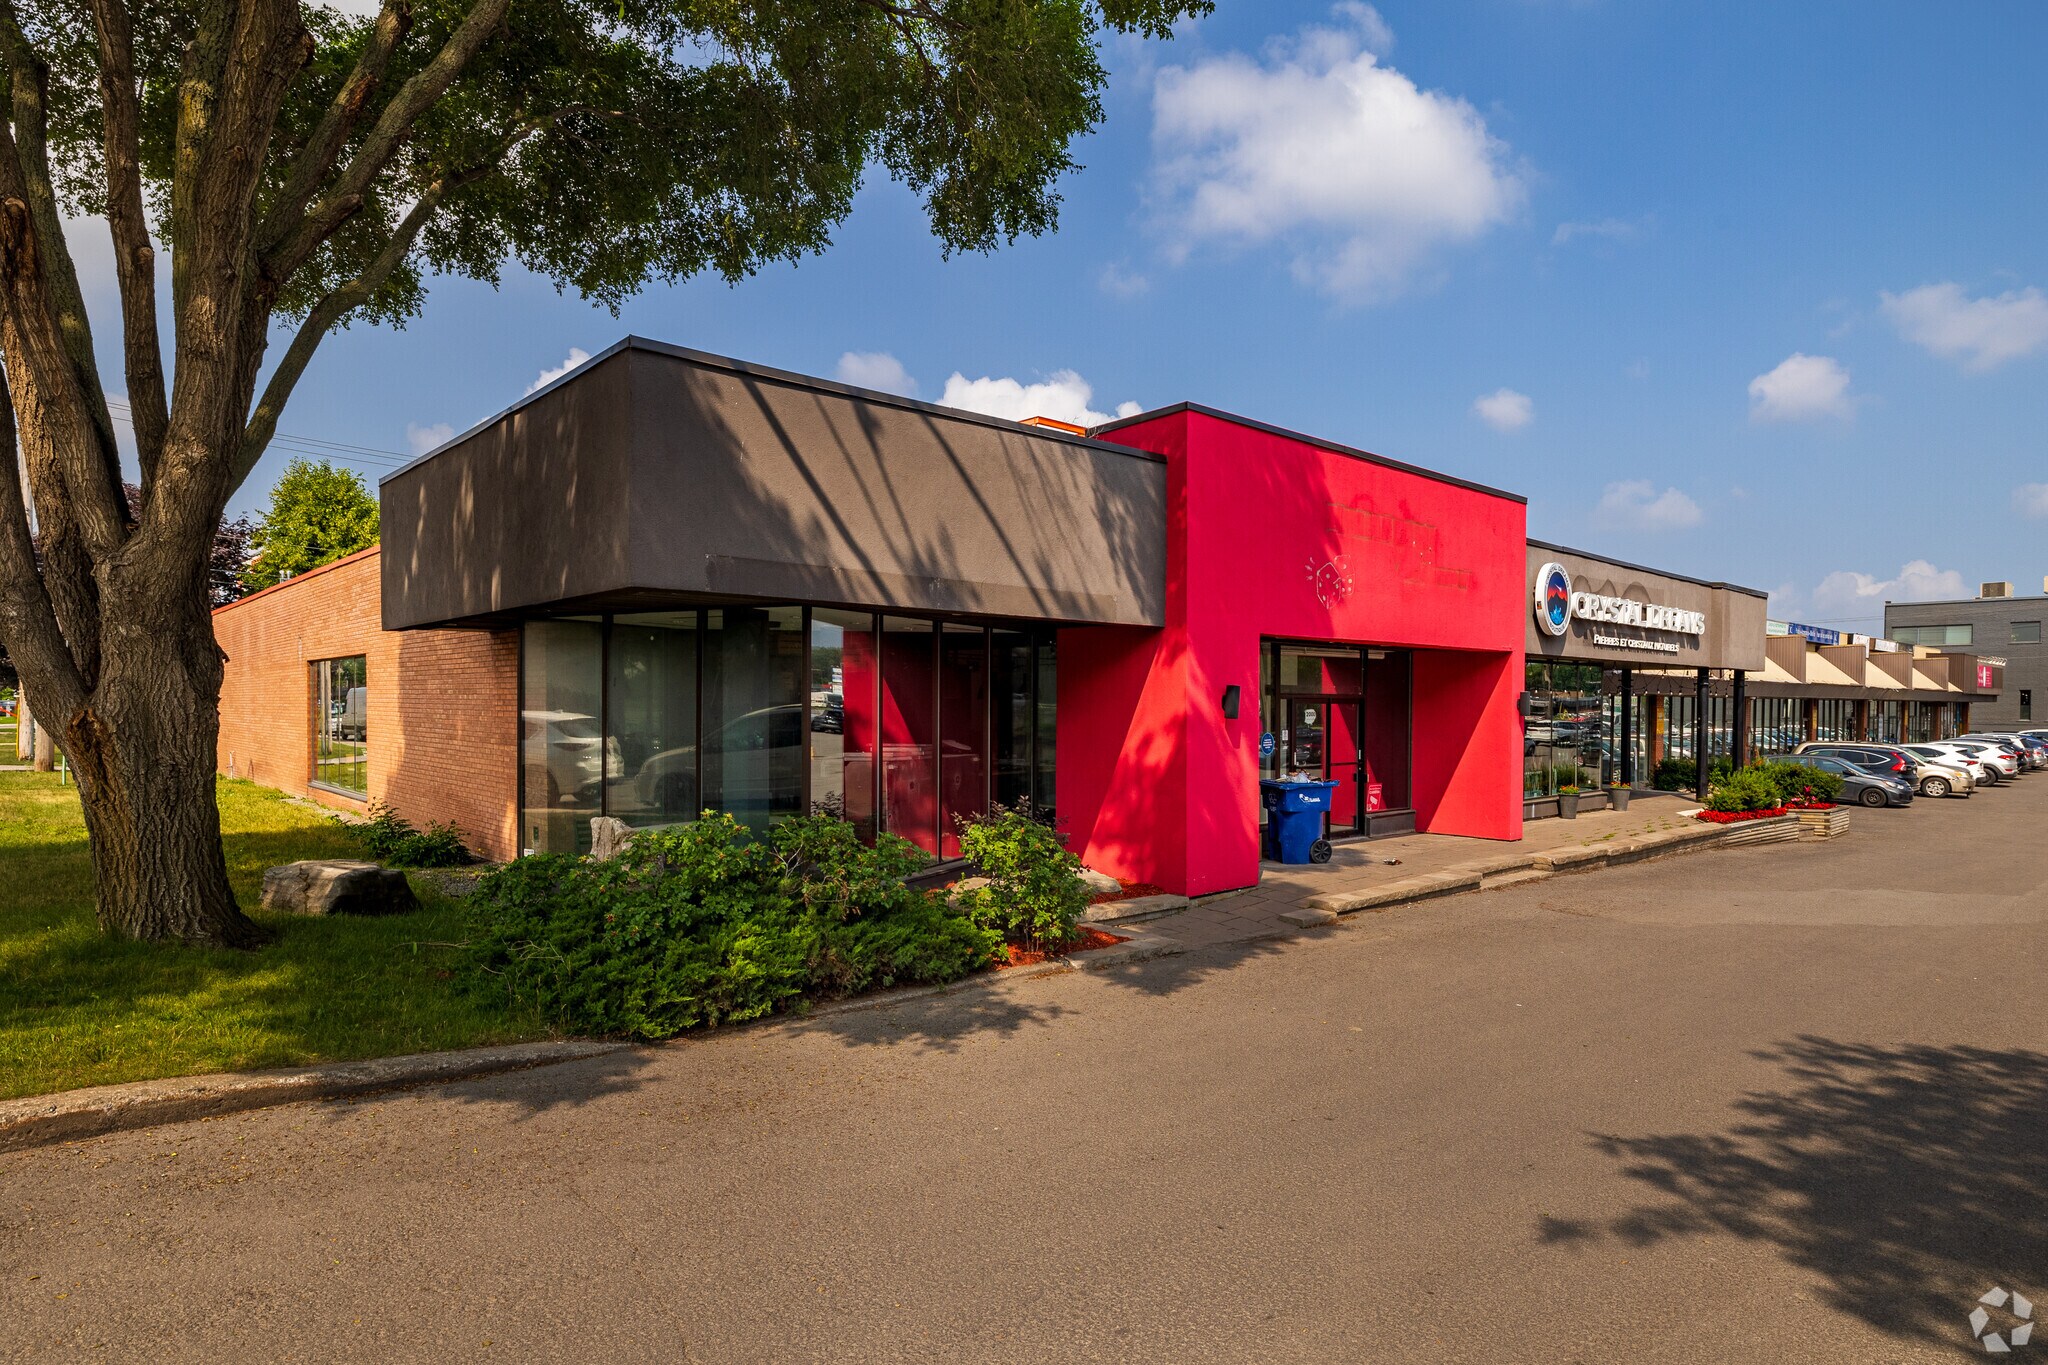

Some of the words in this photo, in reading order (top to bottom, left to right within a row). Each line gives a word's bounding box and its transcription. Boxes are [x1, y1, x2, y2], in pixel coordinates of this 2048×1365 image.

[1573, 591, 1647, 626] CRYSTAL
[1646, 603, 1705, 635] DREAMS
[1620, 638, 1628, 647] ET
